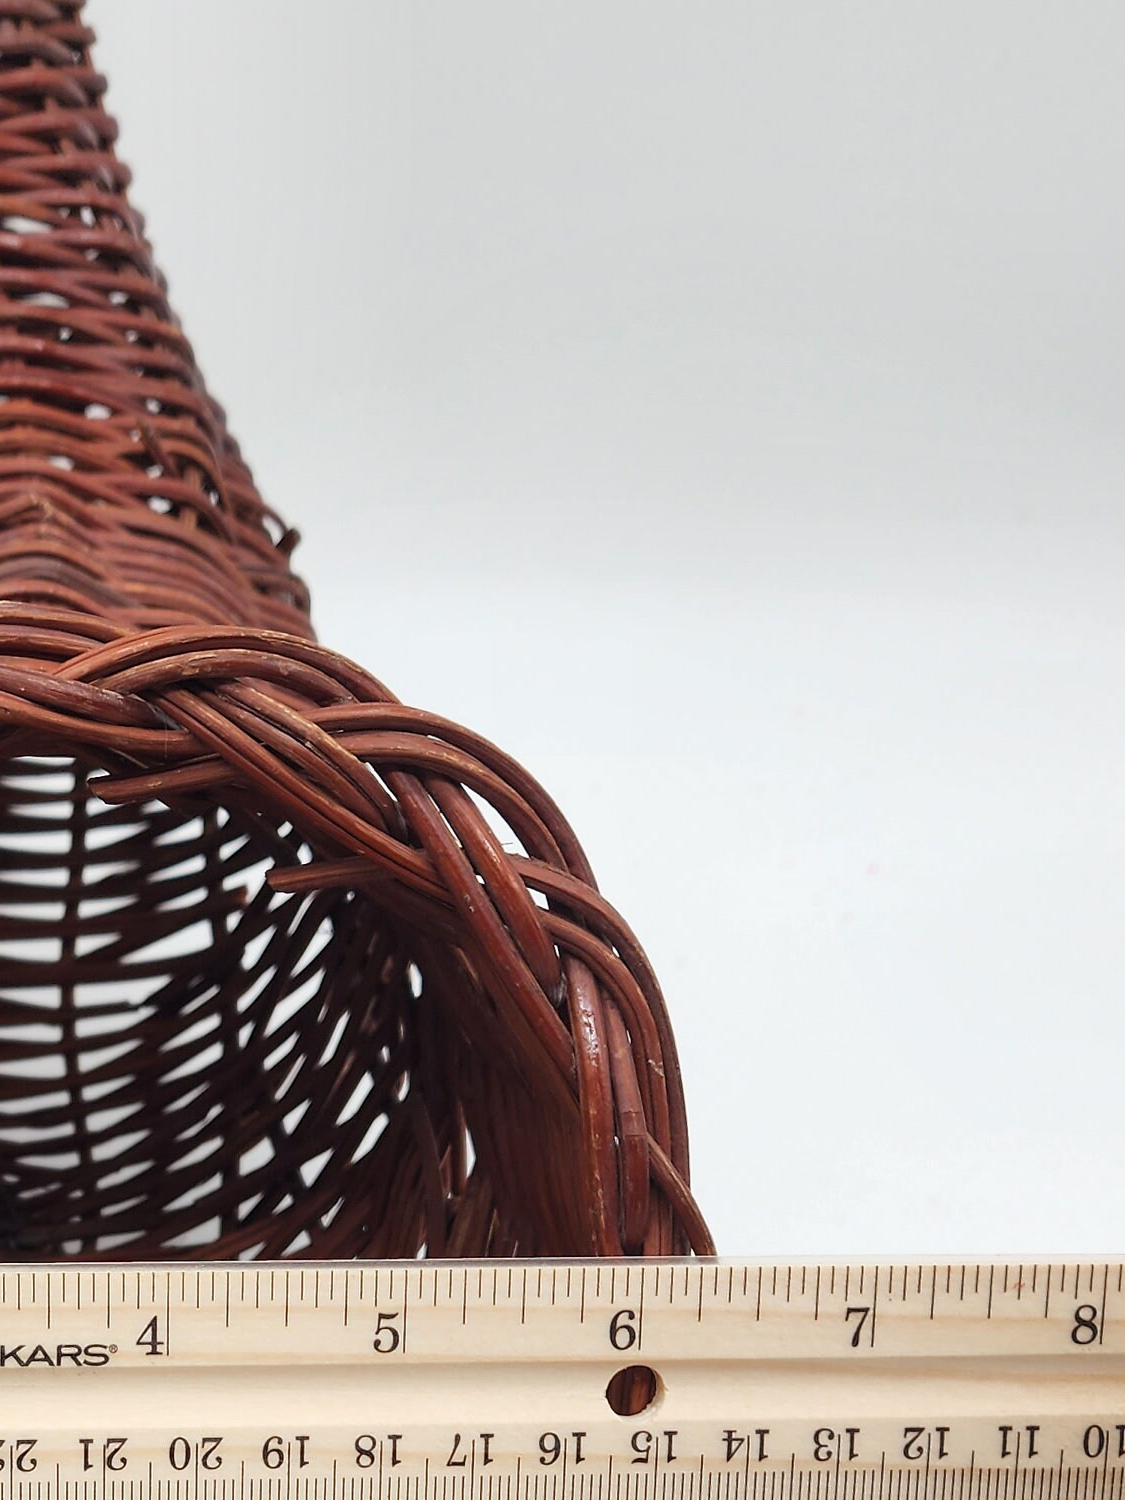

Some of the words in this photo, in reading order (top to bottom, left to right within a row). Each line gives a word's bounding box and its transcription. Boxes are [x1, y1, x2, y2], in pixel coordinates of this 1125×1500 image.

[136, 1316, 164, 1355] 4
[374, 1313, 399, 1353] 5
[609, 1310, 636, 1350] 6
[845, 1307, 871, 1347] 7
[1071, 1305, 1098, 1345] 8
[79, 1438, 128, 1472] 21
[169, 1437, 223, 1470] 20
[262, 1436, 310, 1469] 19
[355, 1435, 402, 1468] 18
[445, 1433, 494, 1467] 17
[539, 1432, 586, 1466] 16
[631, 1431, 678, 1465] 15
[722, 1430, 769, 1463] 14
[813, 1429, 860, 1462] 13
[903, 1427, 950, 1460] 12
[999, 1426, 1040, 1459] 11
